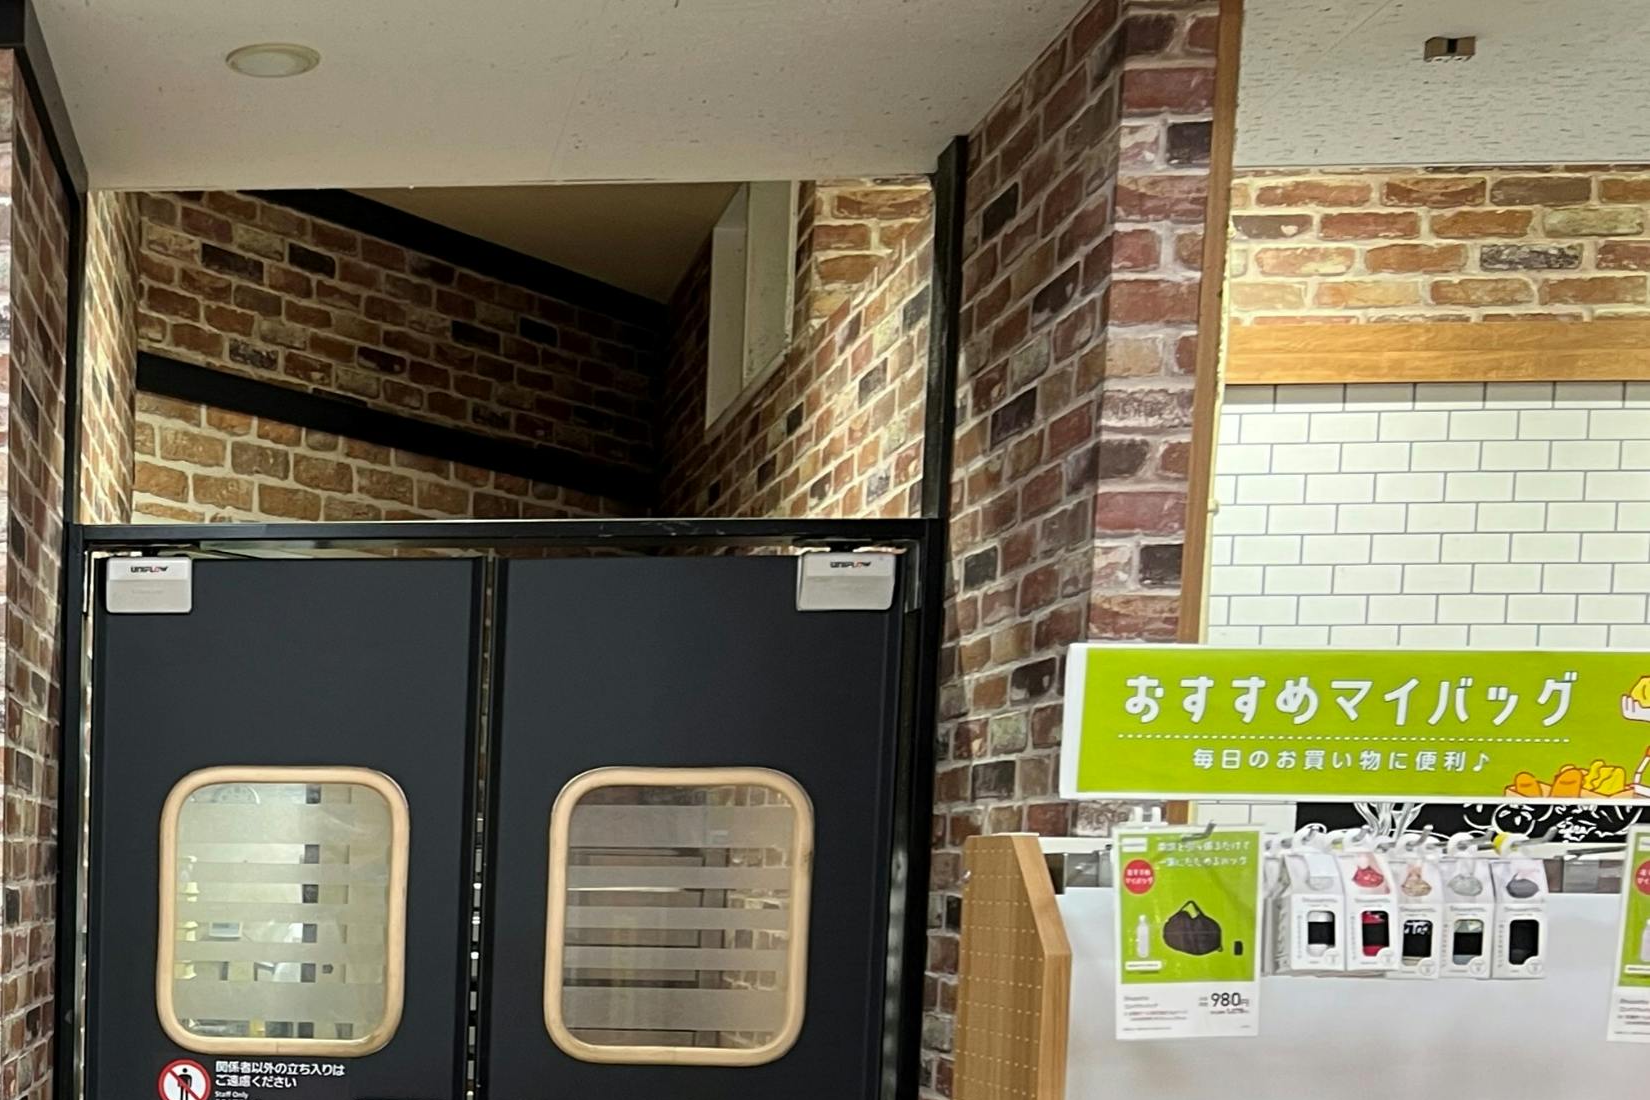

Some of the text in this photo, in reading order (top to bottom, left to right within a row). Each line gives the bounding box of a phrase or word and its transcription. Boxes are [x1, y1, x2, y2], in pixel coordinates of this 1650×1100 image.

[1124, 670, 1579, 727] おすすめマイバッグ
[215, 1061, 345, 1076] 関係者以外の立ち入りは
[215, 1075, 297, 1088] ご遠慮ください
[214, 1090, 249, 1100] Staff Only
